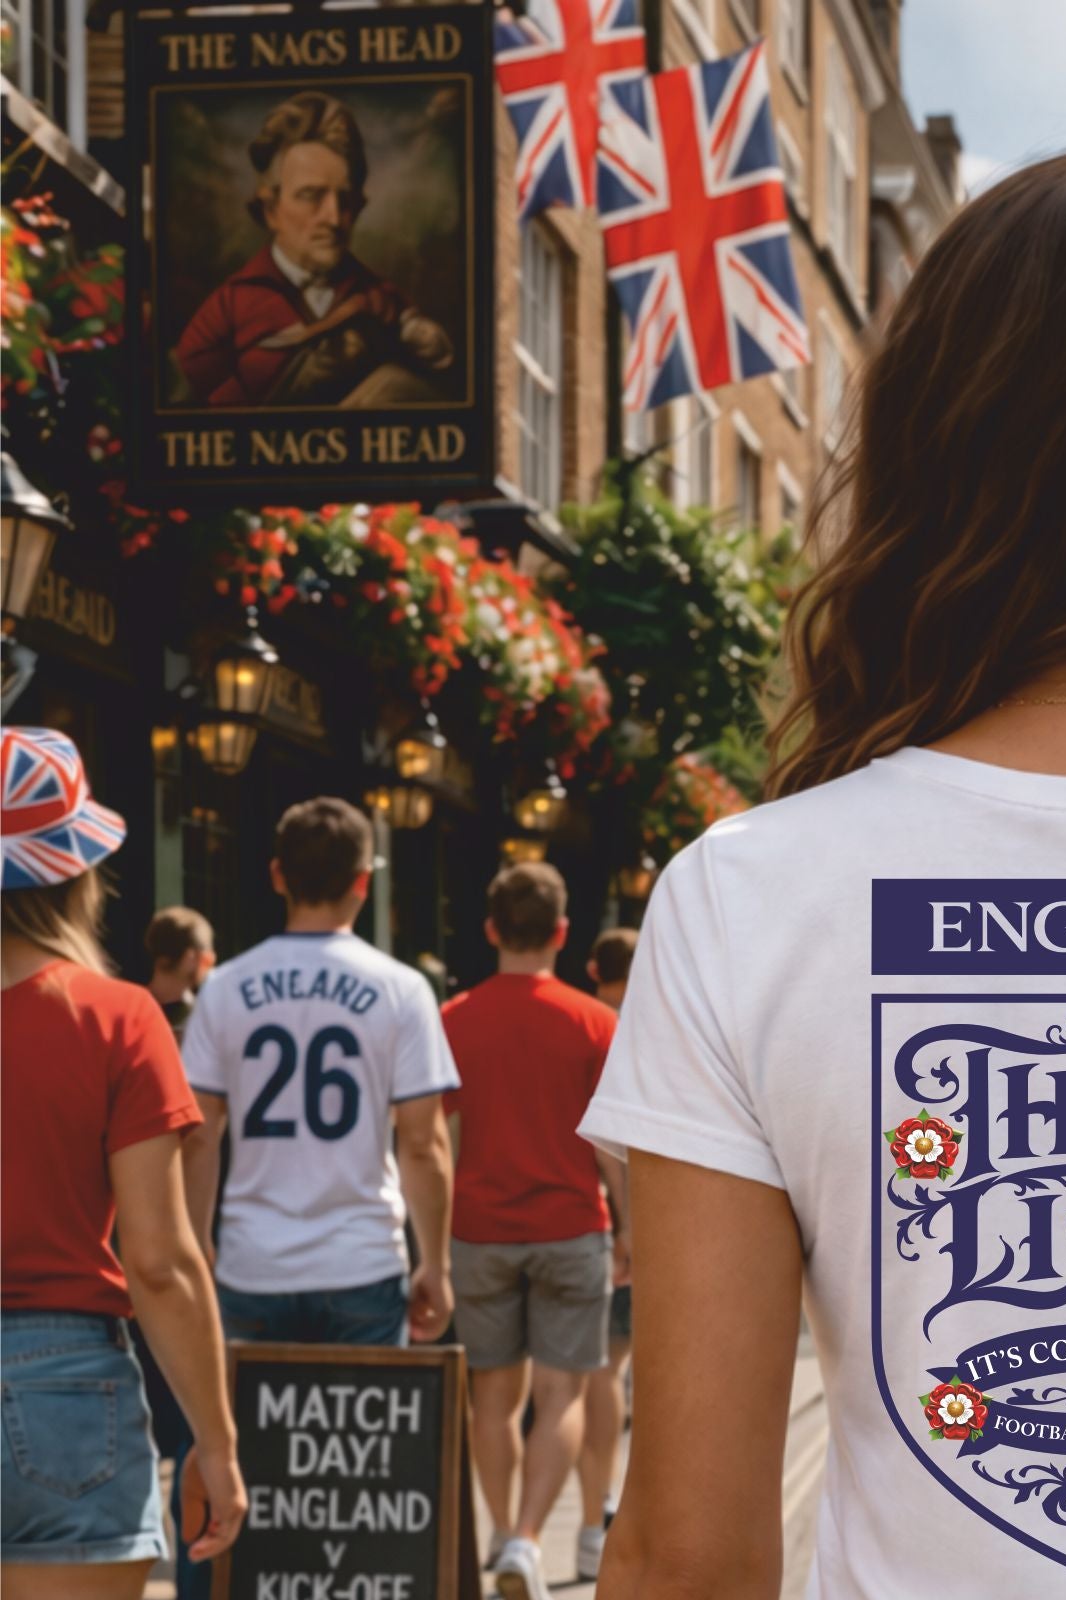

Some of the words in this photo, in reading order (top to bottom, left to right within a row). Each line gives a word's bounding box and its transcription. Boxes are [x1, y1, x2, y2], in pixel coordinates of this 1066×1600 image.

[160, 33, 236, 71] THE
[251, 28, 347, 67] NAGS
[359, 23, 462, 63] HEAD
[161, 430, 236, 467] THE
[251, 427, 347, 464] NAGS
[361, 424, 466, 462] HEAD
[242, 1021, 361, 1142] 26
[965, 1344, 1023, 1382] IT'S
[257, 1382, 421, 1433] MATCH
[248, 1485, 432, 1533] ENGLAND
